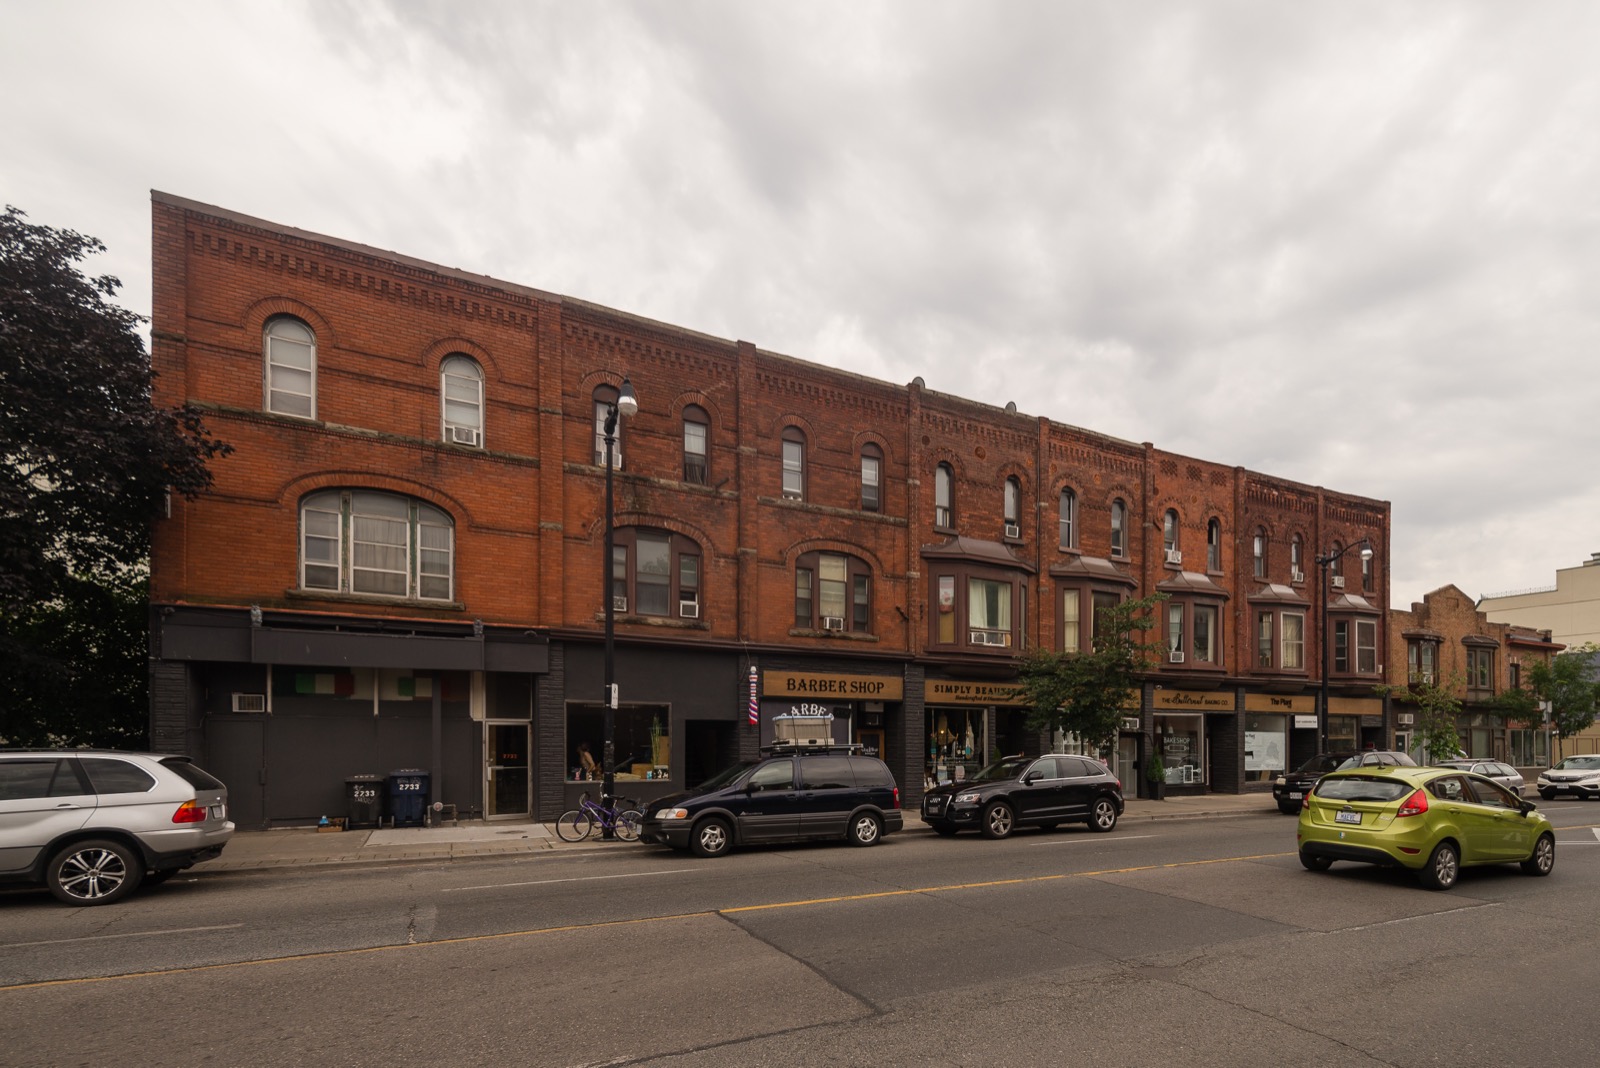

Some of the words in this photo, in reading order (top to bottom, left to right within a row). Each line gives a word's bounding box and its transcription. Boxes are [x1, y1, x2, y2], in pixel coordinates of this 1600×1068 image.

[787, 678, 847, 693] BARBER
[850, 681, 885, 694] SHOP
[934, 684, 972, 694] SIMPLY
[1163, 736, 1190, 744] BAKESHOP
